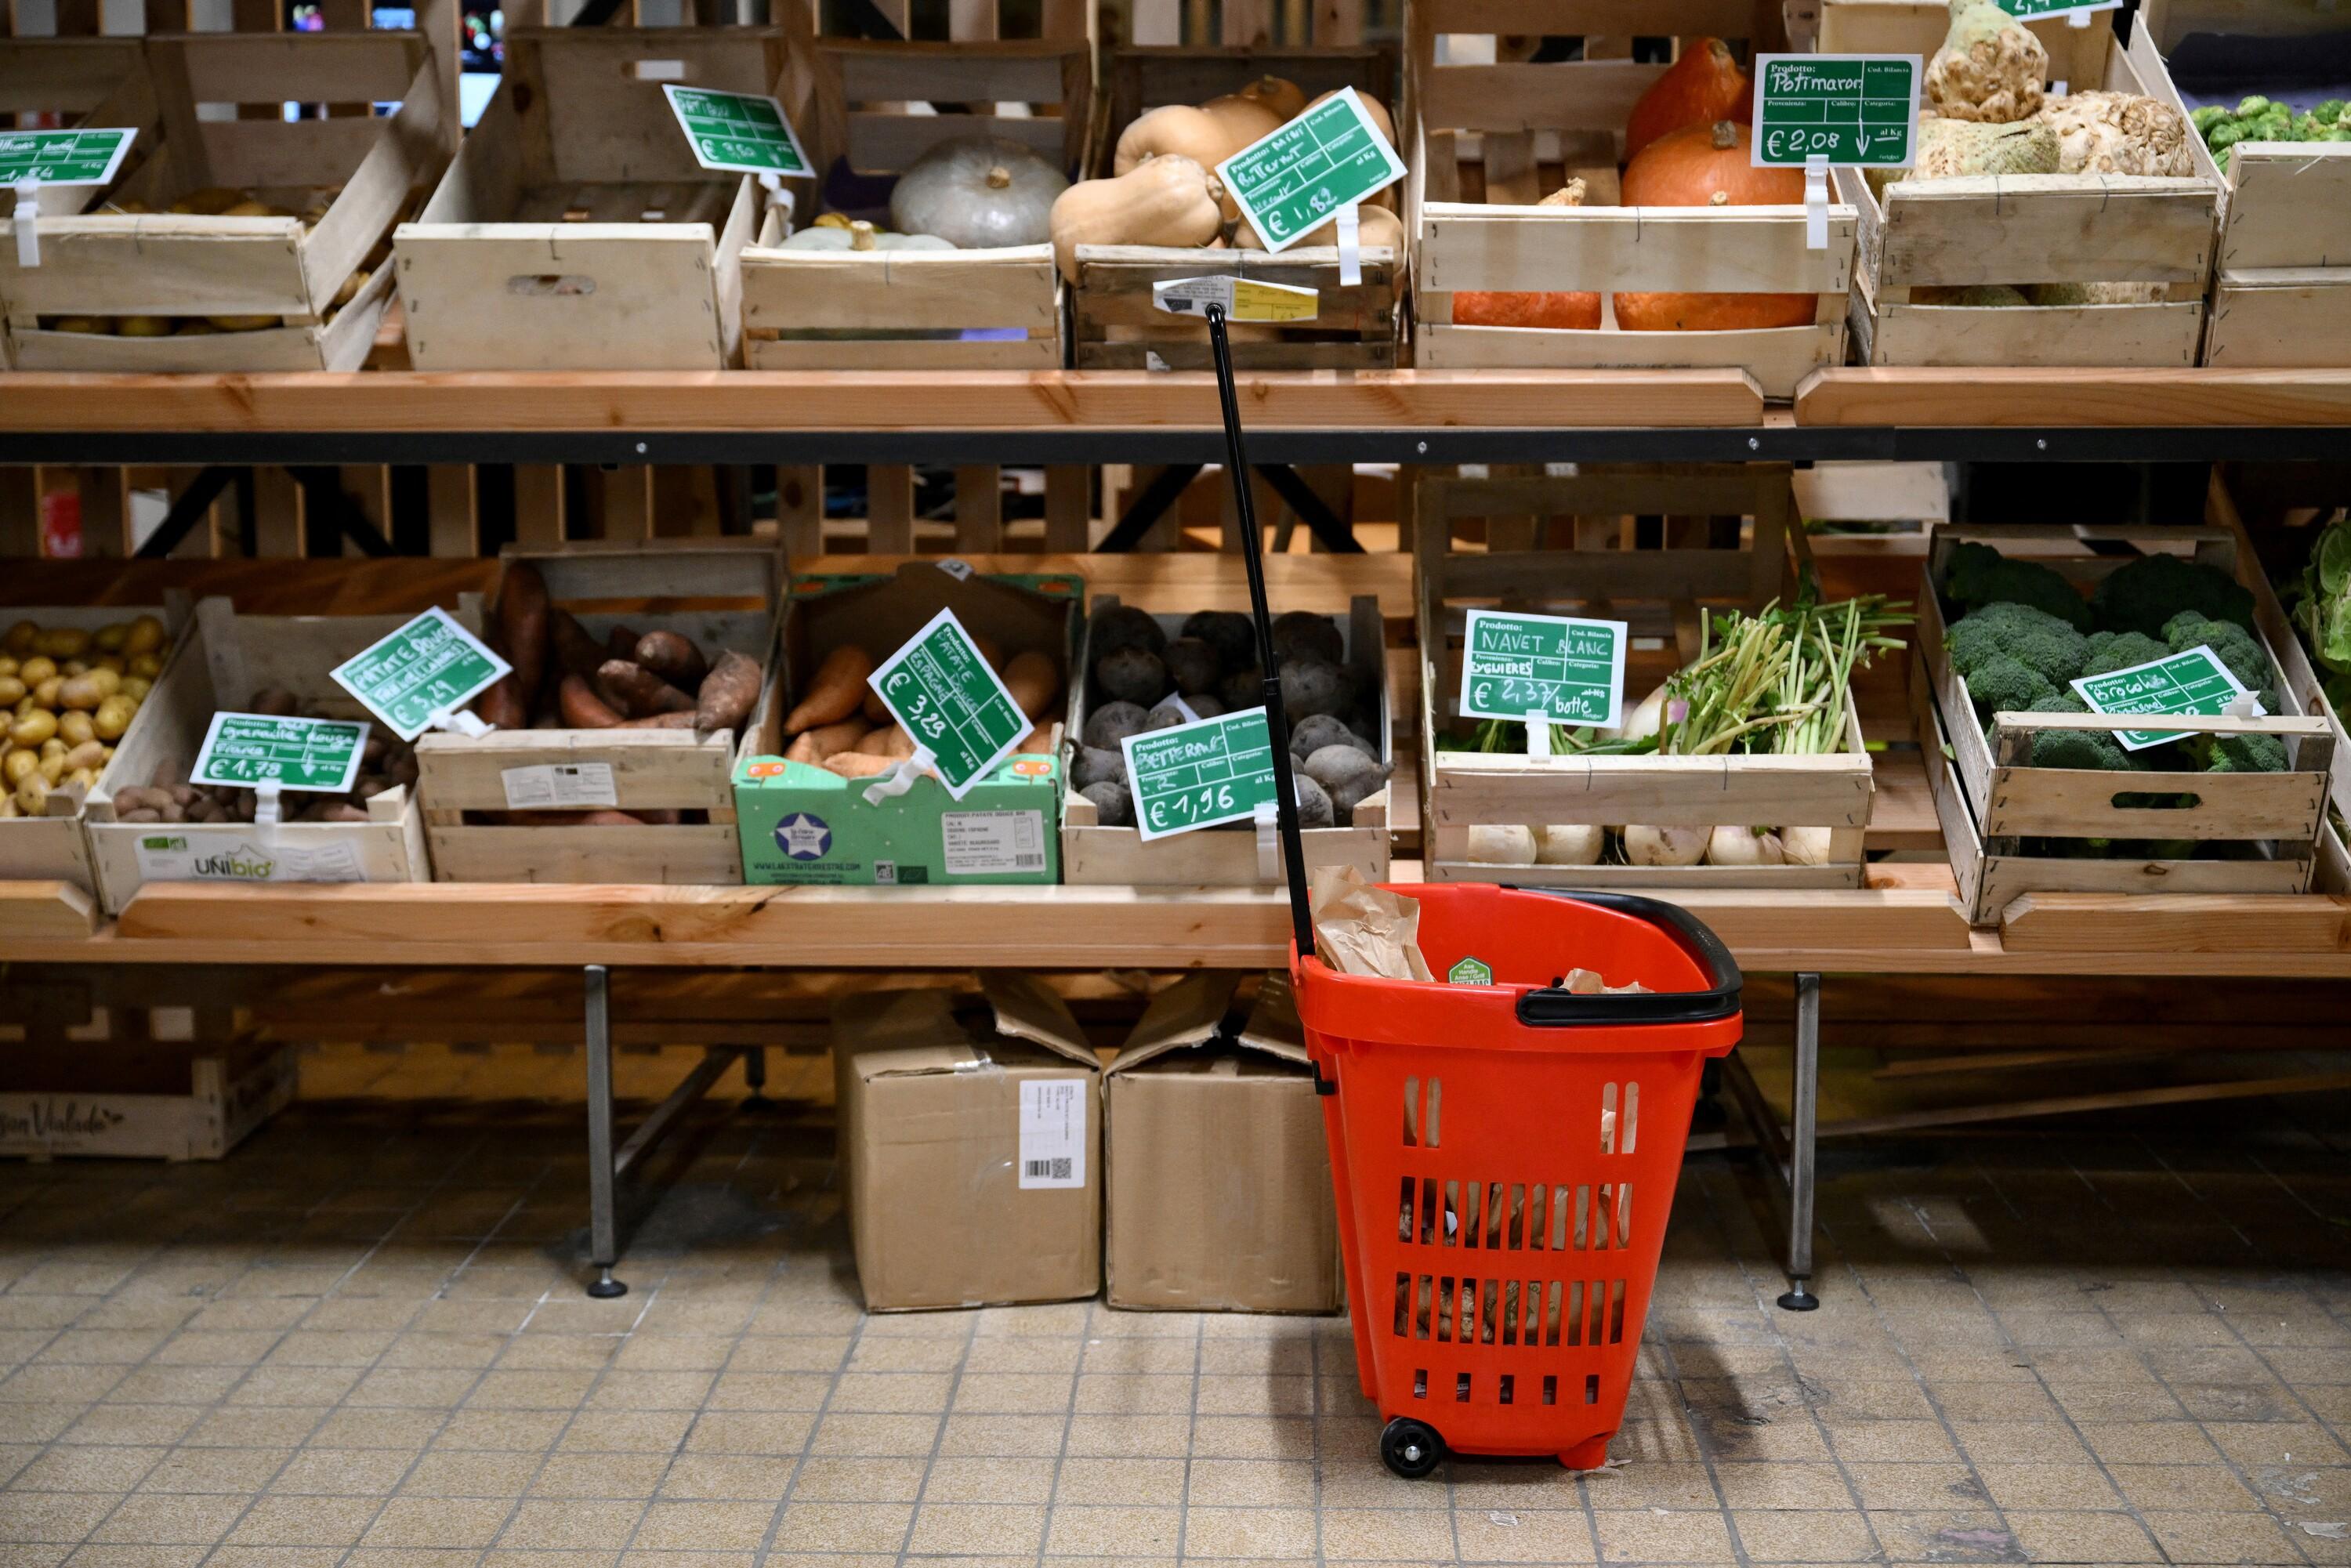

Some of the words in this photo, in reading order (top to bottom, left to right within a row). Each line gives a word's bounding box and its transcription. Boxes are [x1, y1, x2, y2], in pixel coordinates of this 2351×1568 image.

[1770, 64, 1816, 74] Prodotto:
[1766, 130, 1784, 158] €
[1788, 129, 1840, 152] 2,08
[1890, 129, 1903, 137] Kg
[1230, 148, 1270, 174] Prodotto:
[1268, 211, 1291, 236] €
[1480, 621, 1523, 632] Prodotto:
[944, 625, 971, 663] Prodotto:
[1482, 631, 1544, 652] NAVET
[1556, 639, 1608, 655] BLANC
[934, 631, 976, 683] PATATE
[2168, 664, 2182, 672] Cod.
[2183, 656, 2204, 667] Bilancia
[949, 668, 980, 712] DOUCE
[2088, 677, 2126, 690] Prodotto:
[887, 672, 911, 696] €
[907, 694, 946, 739] 3,29
[1474, 683, 1491, 708] €
[1136, 737, 1179, 752] Prodotto:
[1201, 759, 1225, 769] Calibro:
[1233, 751, 1263, 762] Categoria:
[209, 759, 229, 778] €
[232, 759, 282, 778] 1,78
[1255, 776, 1263, 784] al
[1150, 801, 1168, 827] €
[1172, 784, 1234, 823] 1,96
